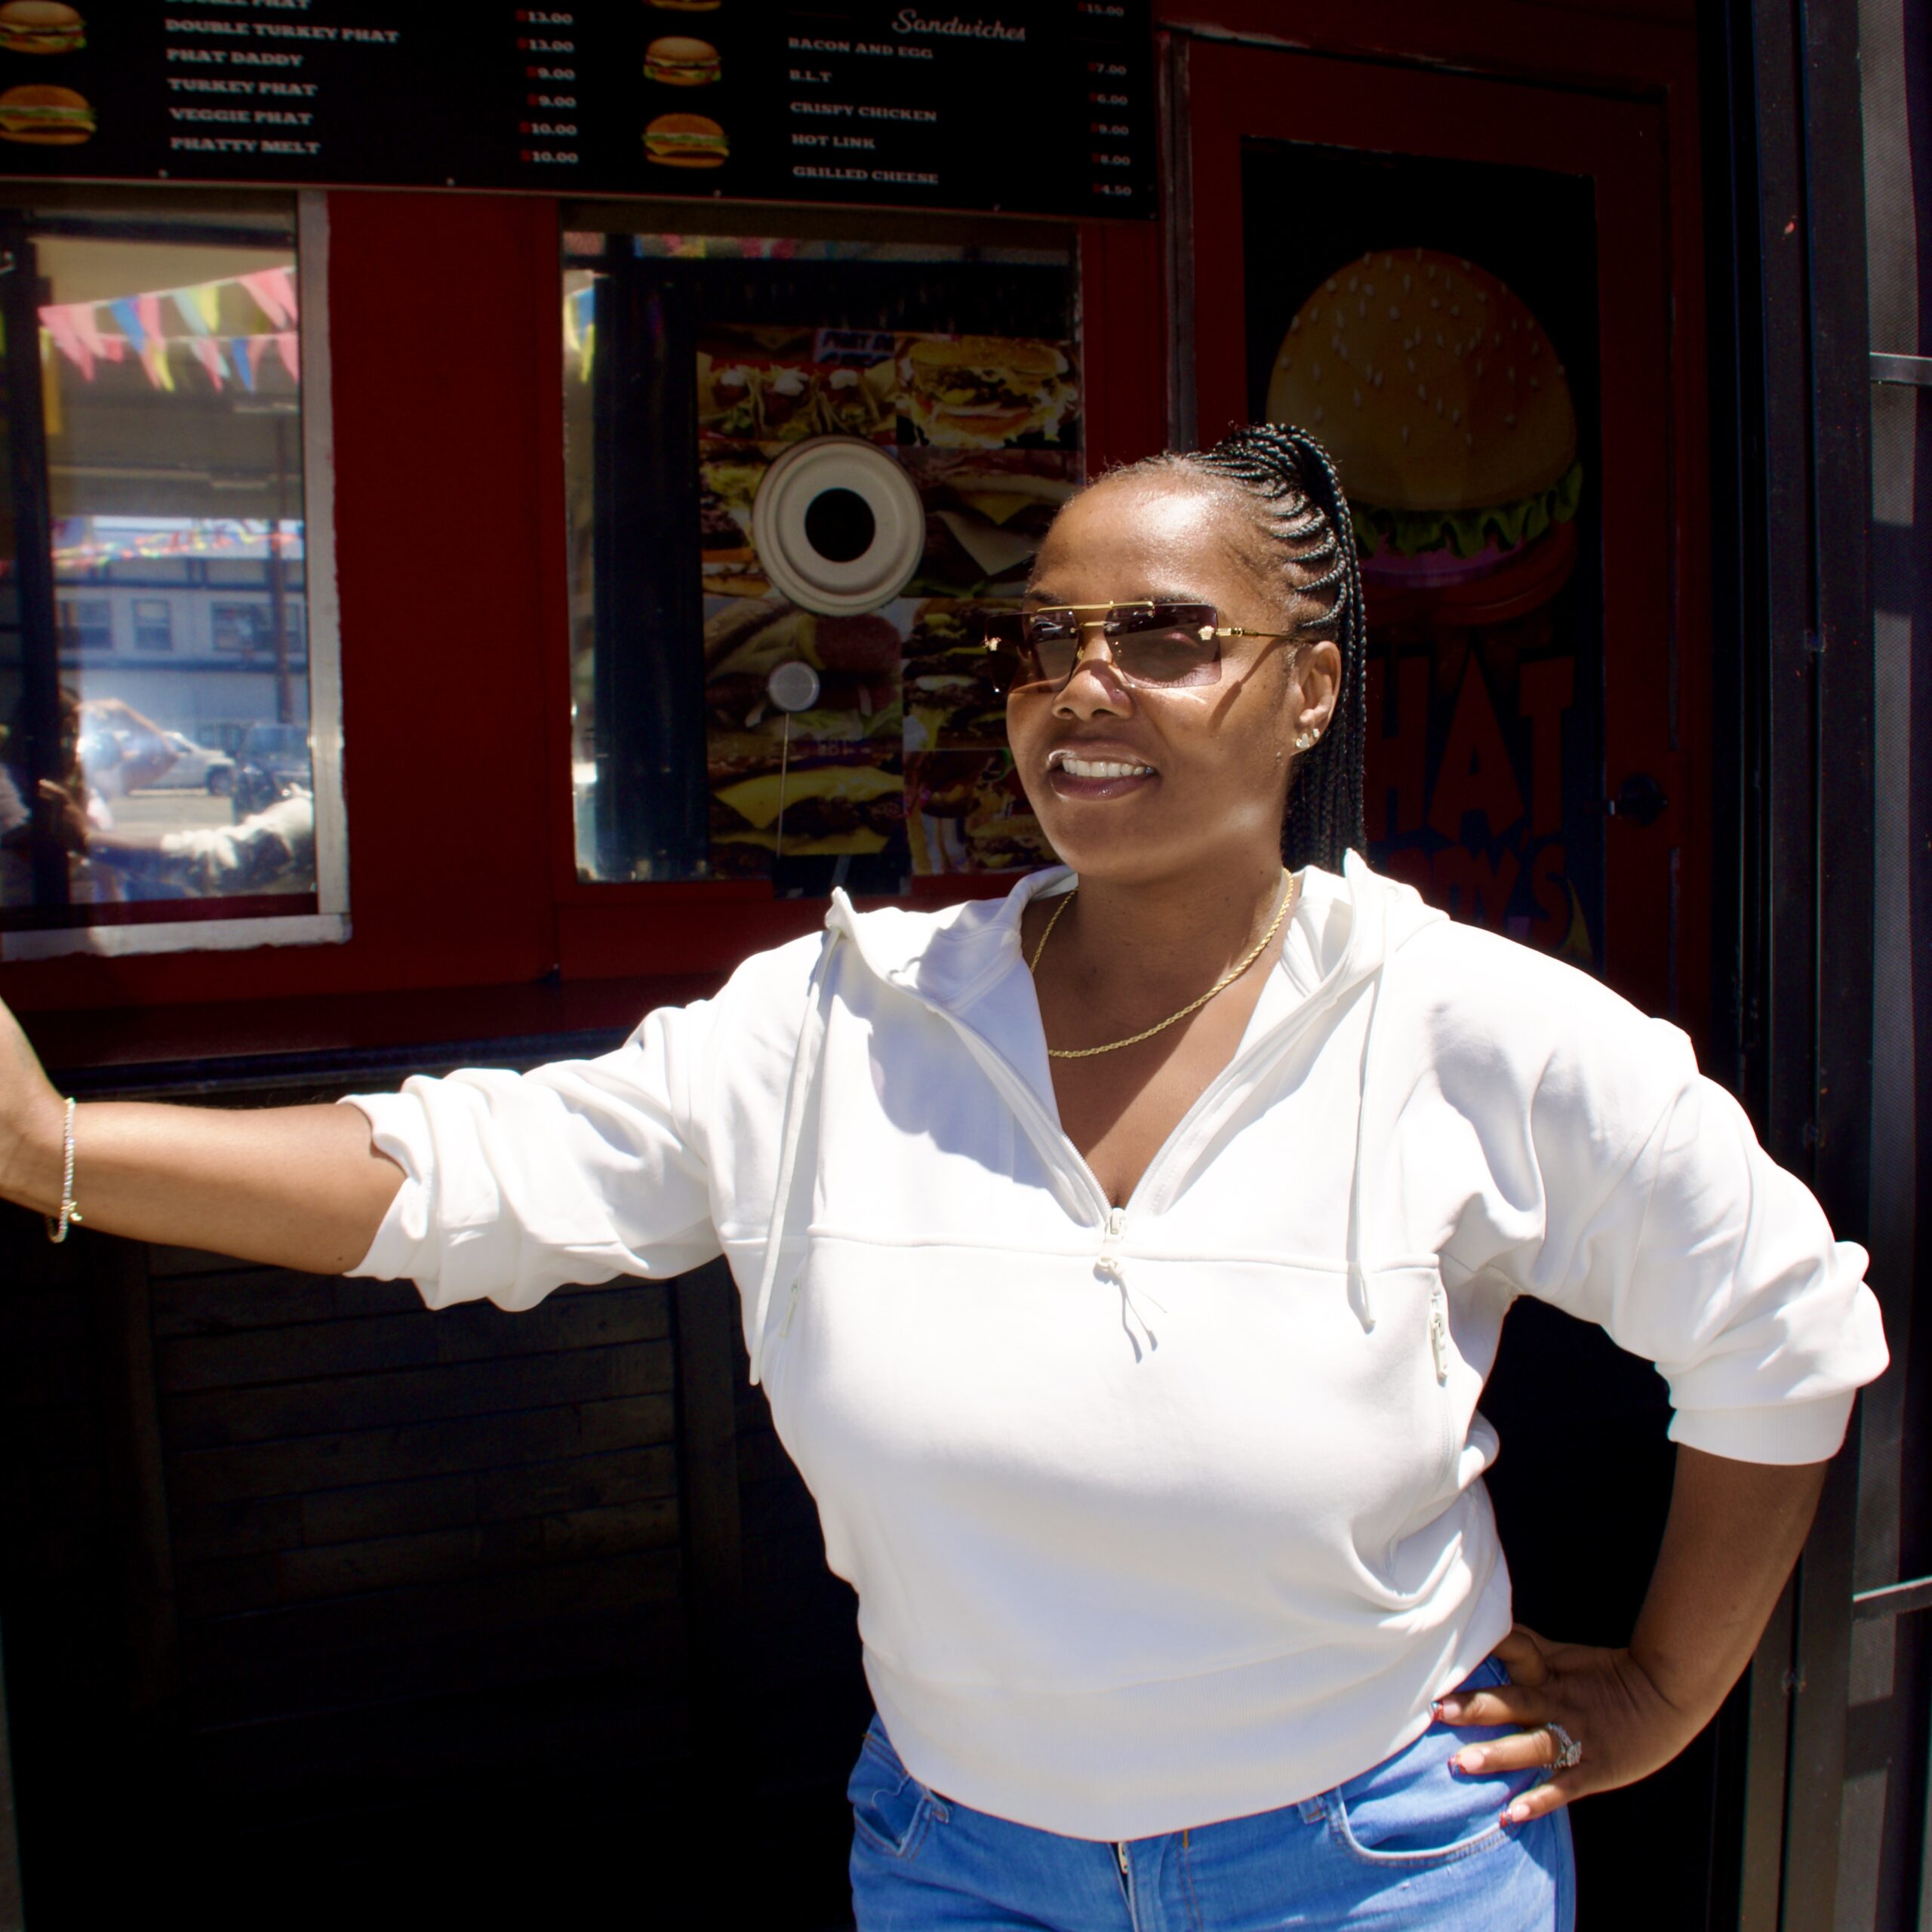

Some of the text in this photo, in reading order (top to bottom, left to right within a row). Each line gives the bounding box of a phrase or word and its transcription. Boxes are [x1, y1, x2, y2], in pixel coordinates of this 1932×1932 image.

[165, 18, 399, 44] DOUBLE TURKEY PHAT
[891, 8, 1026, 42] Sandwiches
[166, 48, 303, 68] PHAT DADDY
[788, 37, 934, 60] BACON AND EGG
[789, 69, 831, 84] B.L.T
[168, 78, 318, 97] TURKEY PHAT
[169, 107, 312, 125] VEGGIE PHAT
[789, 101, 937, 122] CRISPY CHICKEN
[171, 137, 321, 155] PHATTY MELT
[791, 133, 876, 150] HOT LINK
[792, 165, 940, 185] GRILLED CHEESE
[1363, 651, 1577, 841] HAT
